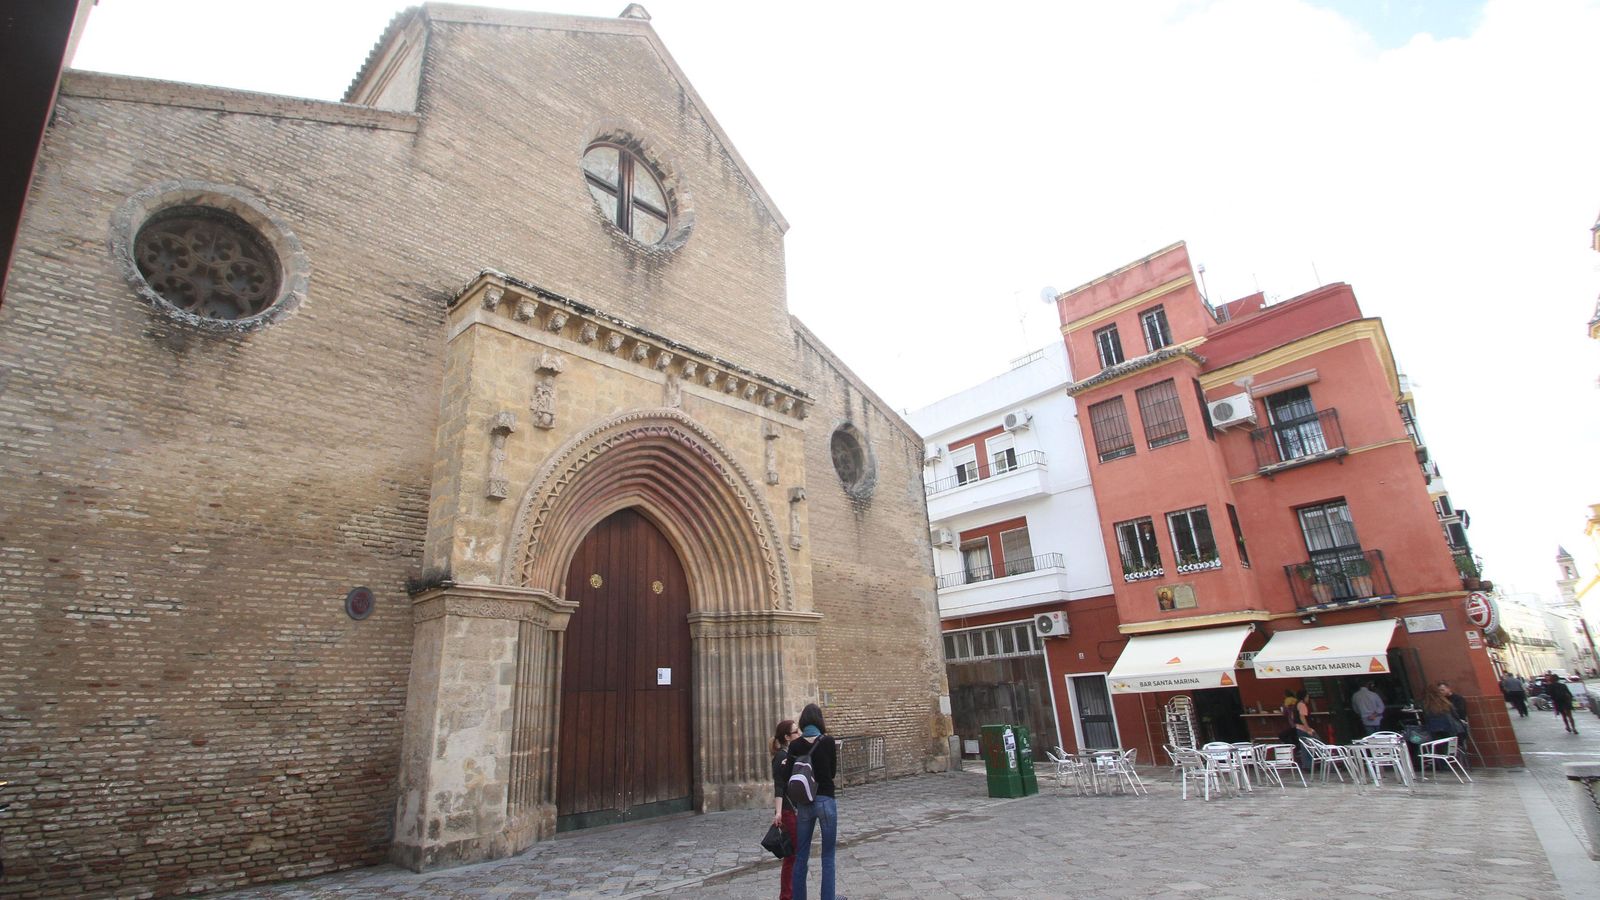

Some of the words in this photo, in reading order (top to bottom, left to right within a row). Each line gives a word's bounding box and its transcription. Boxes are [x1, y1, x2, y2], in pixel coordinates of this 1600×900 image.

[1302, 663, 1327, 672] SANTA
[1328, 662, 1362, 670] MARINA
[1153, 679, 1173, 687] SANTA
[1173, 677, 1200, 685] MARINA
